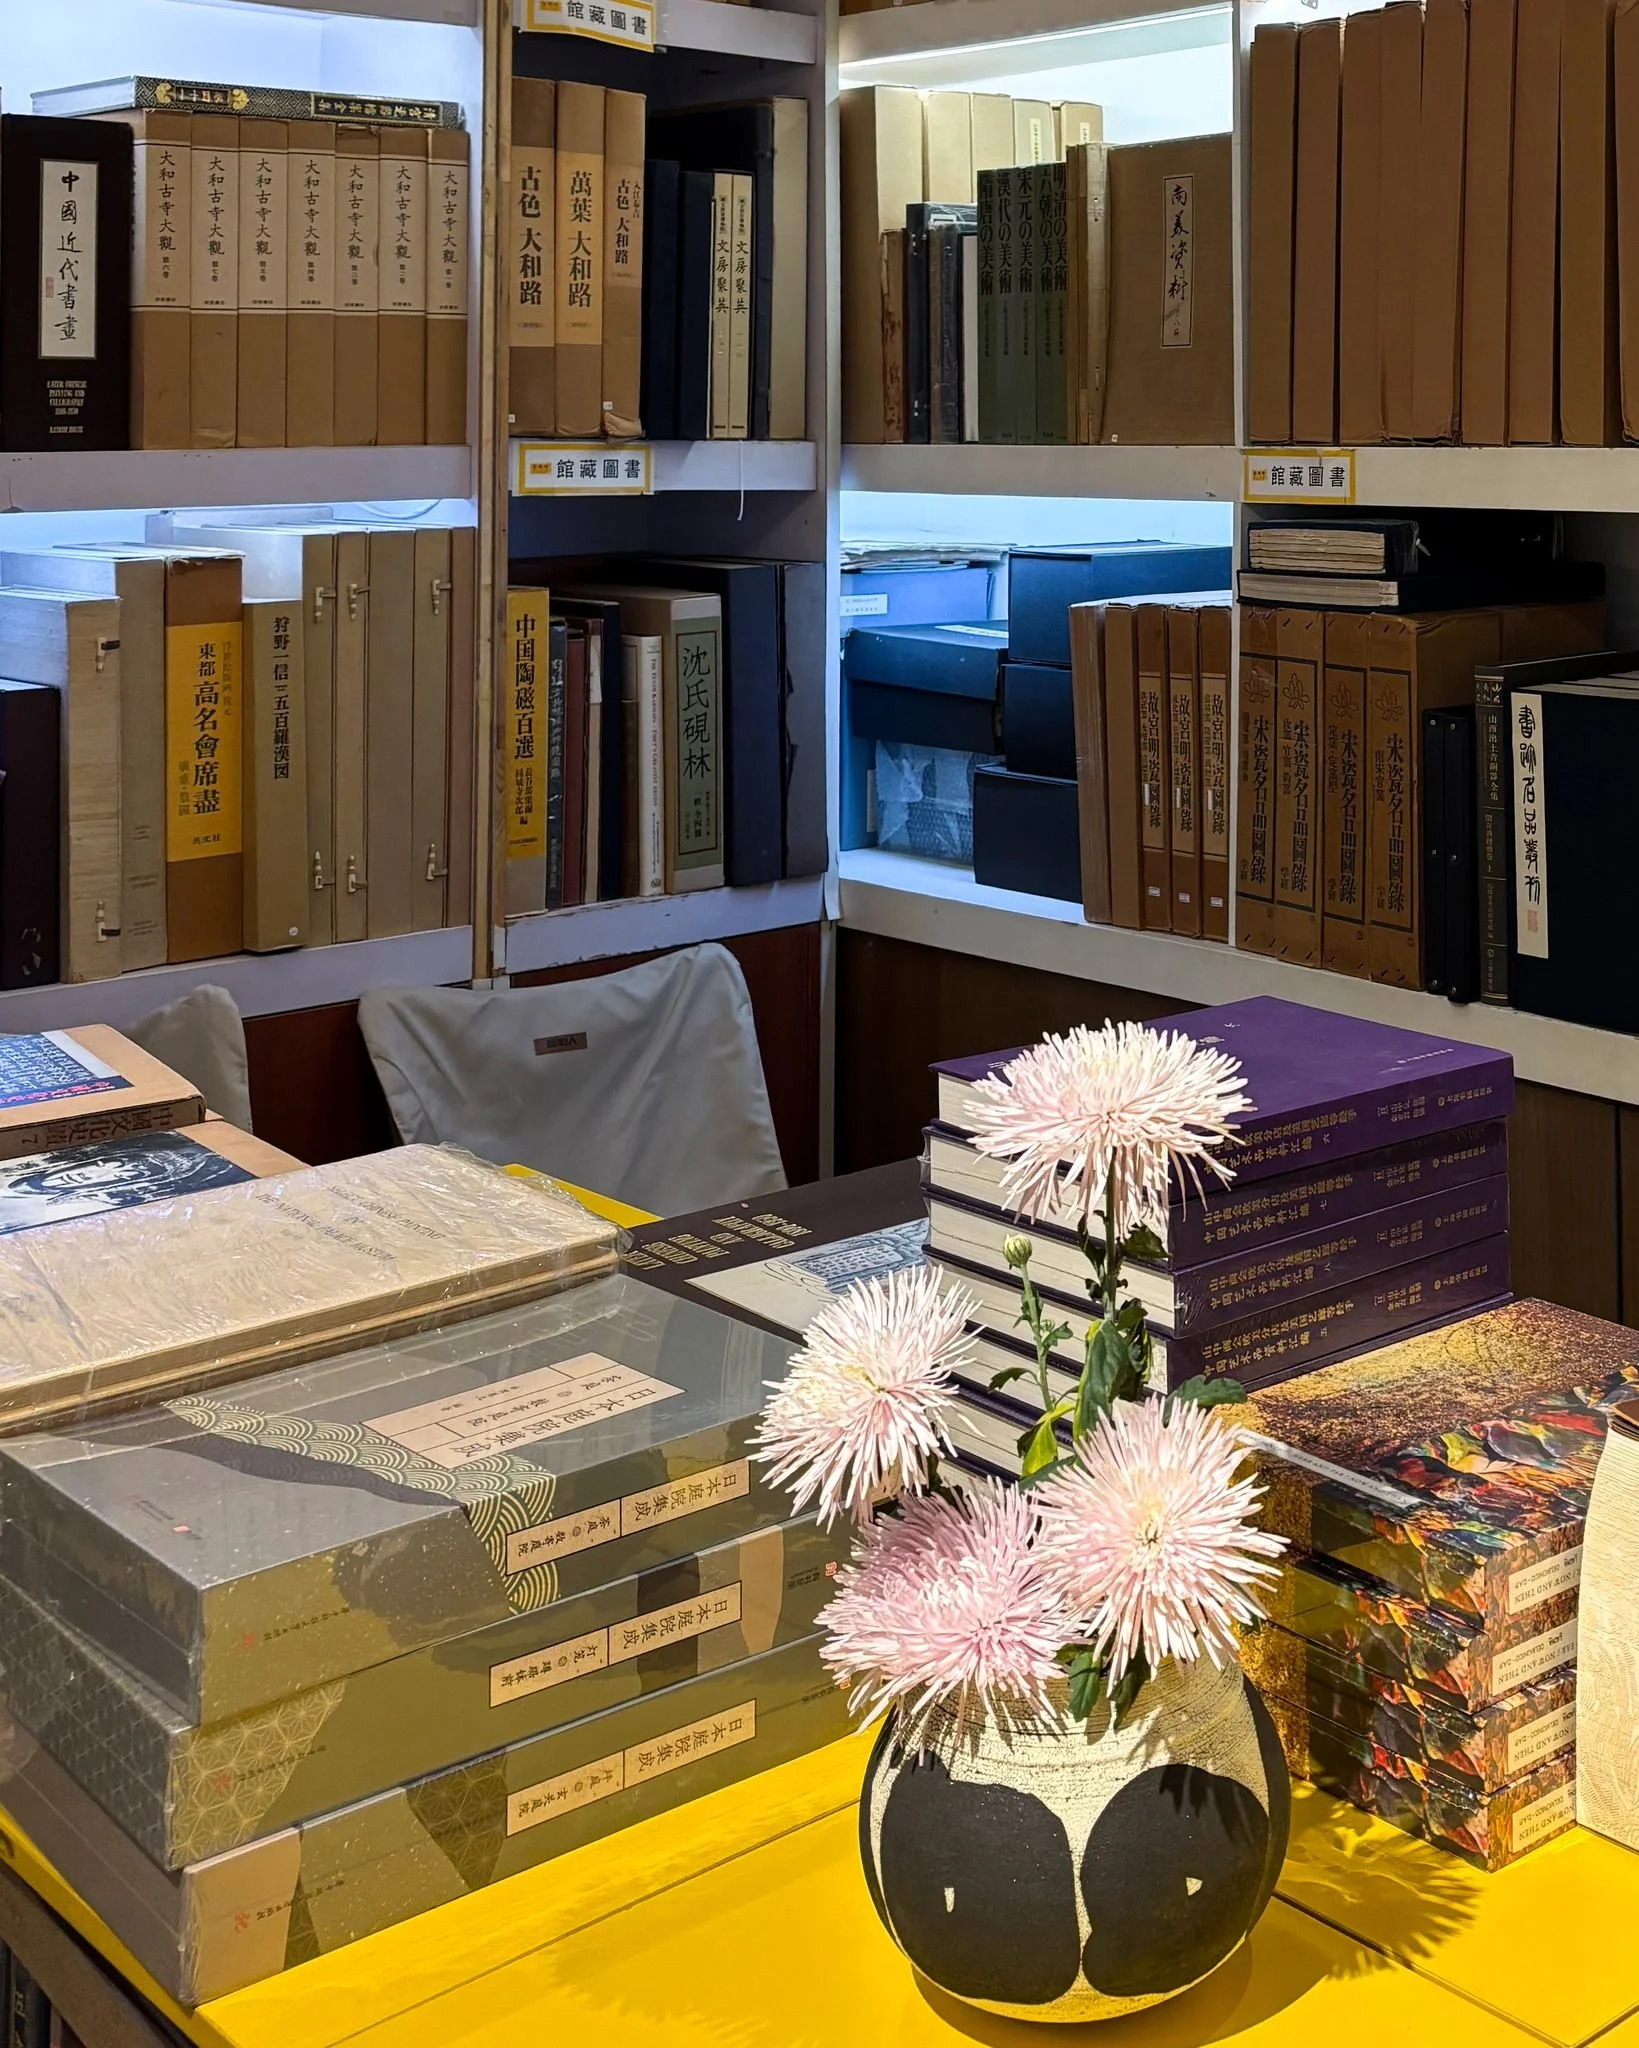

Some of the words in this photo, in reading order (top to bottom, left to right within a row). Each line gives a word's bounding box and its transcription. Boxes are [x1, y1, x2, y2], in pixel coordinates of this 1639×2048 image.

[567, 0, 647, 35] 館藏圖書
[519, 166, 541, 219] 古色
[569, 170, 592, 223] 萬葉
[614, 217, 629, 264] 大和路
[1017, 167, 1033, 293] 宋元の美術
[54, 170, 84, 341] 中國近代書畫
[519, 227, 543, 306] 大和路
[568, 230, 592, 308] 大和路
[557, 459, 641, 480] 館藏圖書
[1271, 466, 1345, 488] 館藏圖書
[514, 613, 535, 760] 中国陶磁百選
[682, 646, 710, 780] 沈氏硯林
[634, 1472, 738, 1521] 日本庭院集成
[1514, 1587, 1535, 1605] THEN
[1536, 1580, 1552, 1594] AND
[622, 1599, 728, 1649] 日本庭院集成
[1498, 1667, 1518, 1684] THEN
[1520, 1658, 1537, 1674] AND
[637, 1718, 744, 1773] 日本庭院集成
[1514, 1745, 1533, 1762] THEN
[1535, 1735, 1551, 1750] AND
[1519, 1822, 1539, 1841] THEN
[1540, 1813, 1555, 1828] AND
